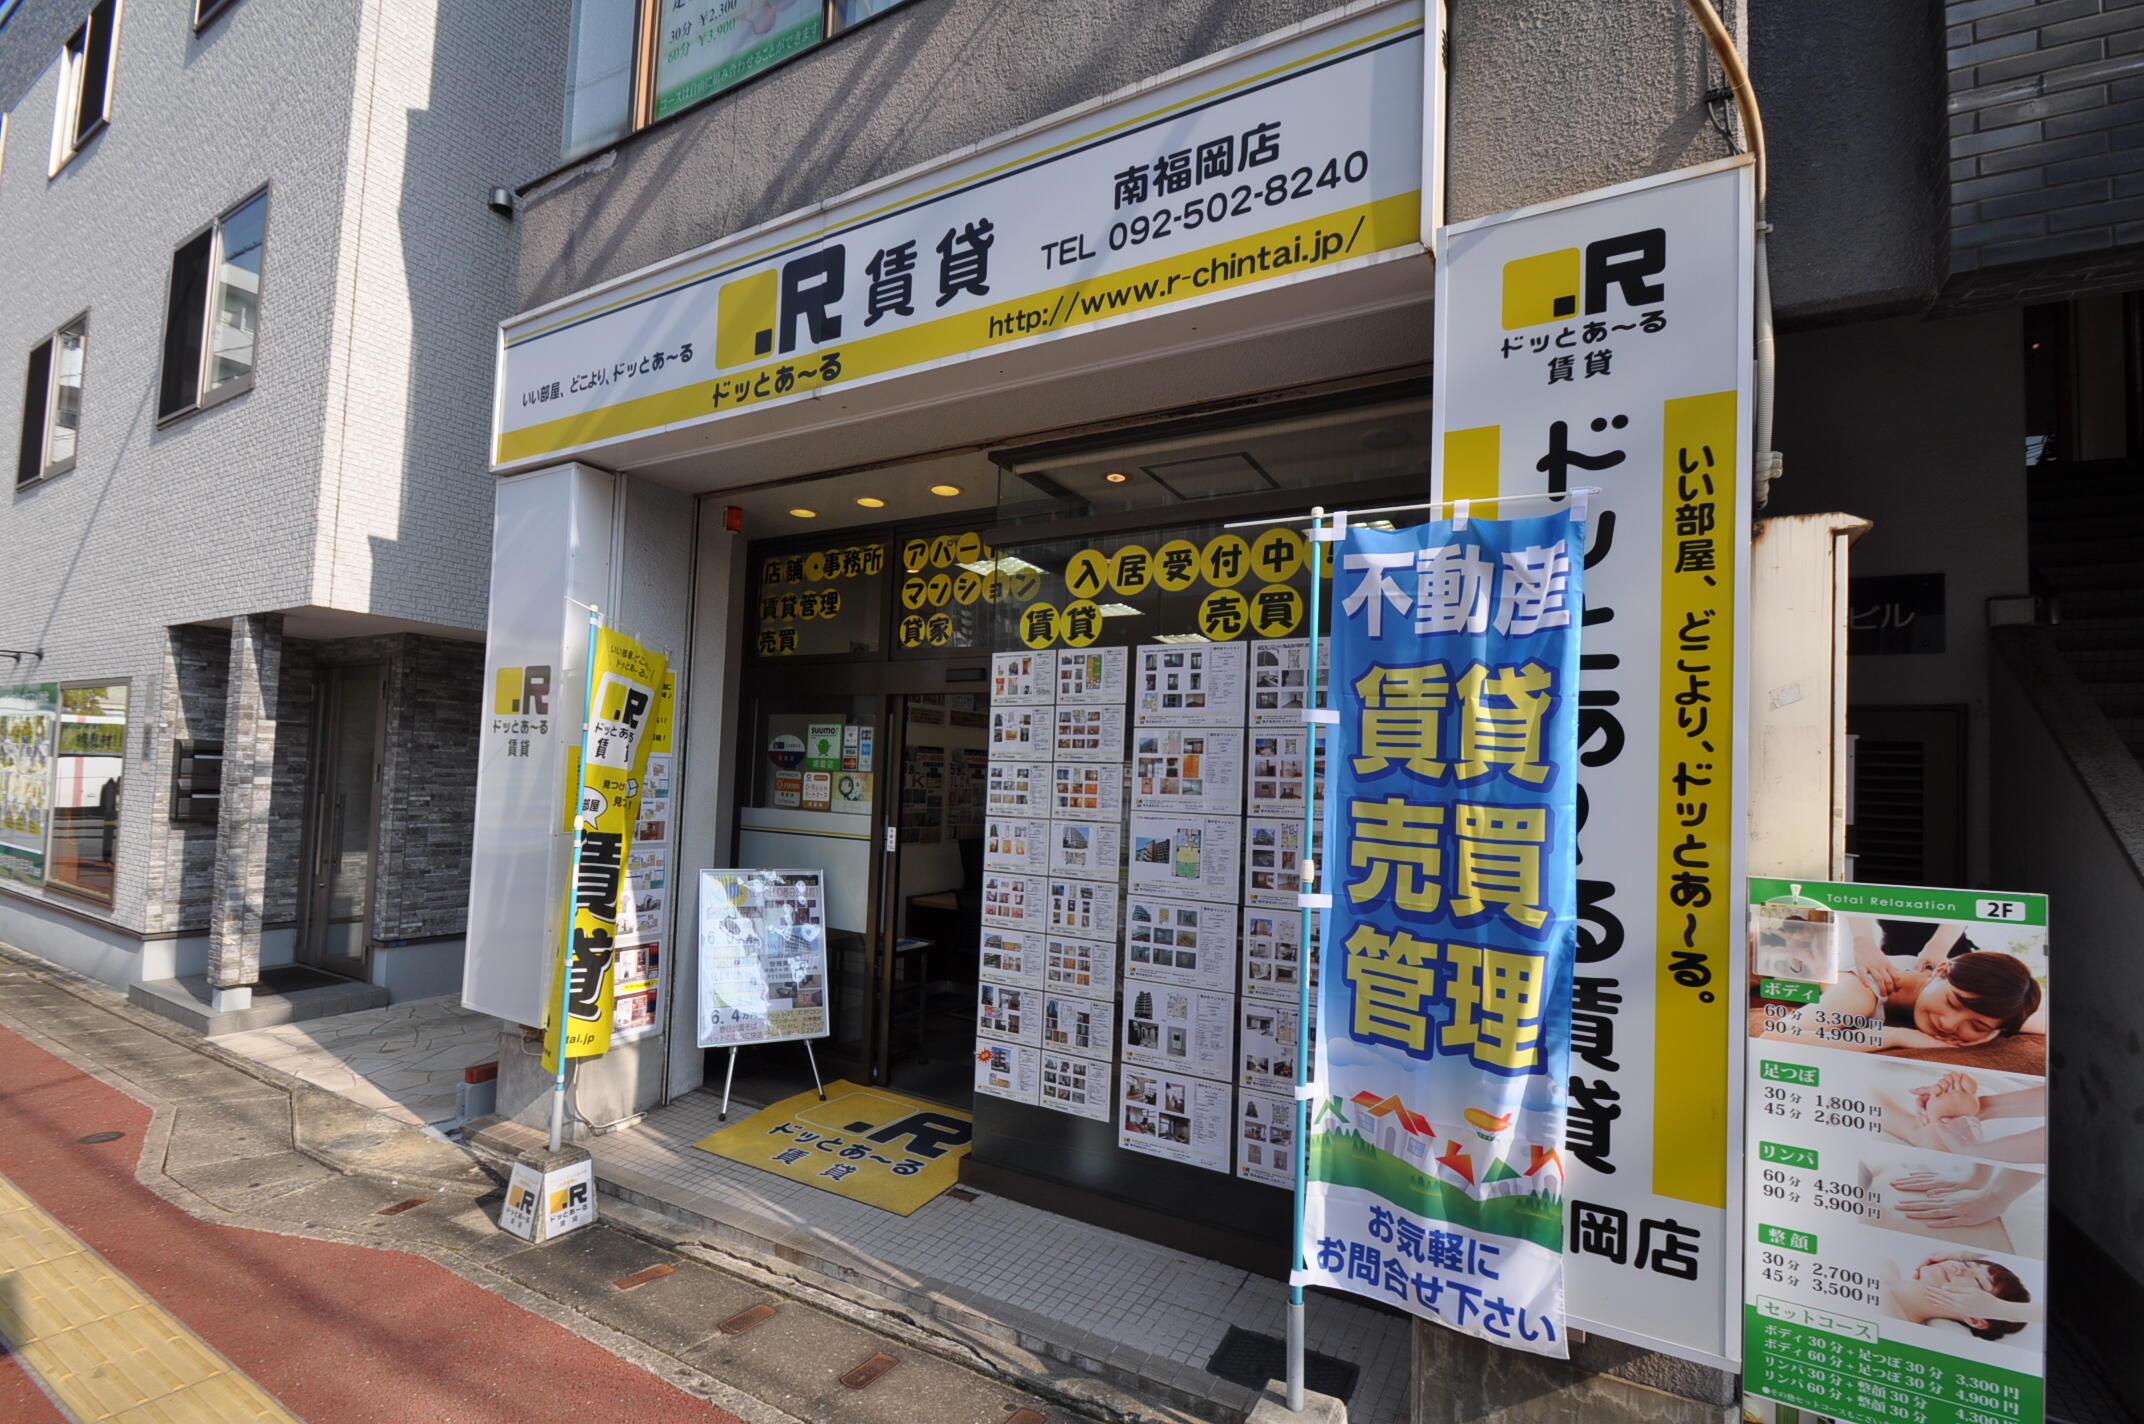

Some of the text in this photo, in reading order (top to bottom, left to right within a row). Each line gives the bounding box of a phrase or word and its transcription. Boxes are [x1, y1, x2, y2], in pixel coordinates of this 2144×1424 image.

[1113, 120, 1282, 211] 南福岡店
[1040, 149, 1370, 271] TEL 092-502-8240
[863, 216, 995, 328] 賃貸
[988, 214, 1368, 340] http://www.r-chintai.jp/
[1547, 349, 1613, 386] 賃貸
[761, 590, 840, 620] 賃貸管理
[904, 570, 1037, 605] マンション
[1340, 538, 1571, 638] 不動産
[902, 615, 951, 646] 貸家
[1024, 603, 1098, 644] 賃貸
[1204, 591, 1297, 637] 売買
[758, 629, 797, 654] 売買
[1351, 660, 1555, 785] 賃貸
[506, 739, 531, 758] 賃貸
[1347, 797, 1549, 929] 売買
[1826, 893, 1957, 912] Total Relaxation
[1986, 902, 2014, 918] 2F
[1344, 924, 1548, 1069] 管理
[1763, 981, 1813, 1001] ボディ
[1764, 1003, 1883, 1031] 60分 3,300円
[1764, 1019, 1883, 1047] 90分 4,900円
[1763, 1061, 1817, 1084] 足つぼ
[1763, 1086, 1883, 1117] 30分 1,800円
[1763, 1102, 1882, 1134] 45分 2,600円
[770, 1147, 858, 1182] 賃貸
[1762, 1144, 1815, 1166] リンパ
[1762, 1168, 1882, 1204] 60分 4,300円
[1762, 1184, 1881, 1220] 90分 5,900円
[1368, 1204, 1501, 1281] お気軽に
[1767, 1227, 1809, 1250] 整顔
[1761, 1251, 1880, 1290] 30分 2,700円
[1761, 1268, 1880, 1306] 45分 3,500円
[1316, 1235, 1558, 1343] お問合せ下さい
[1763, 1299, 1872, 1340] セットコース
[1954, 1373, 2021, 1401] 3,300円
[1954, 1389, 2020, 1416] 4,900円
